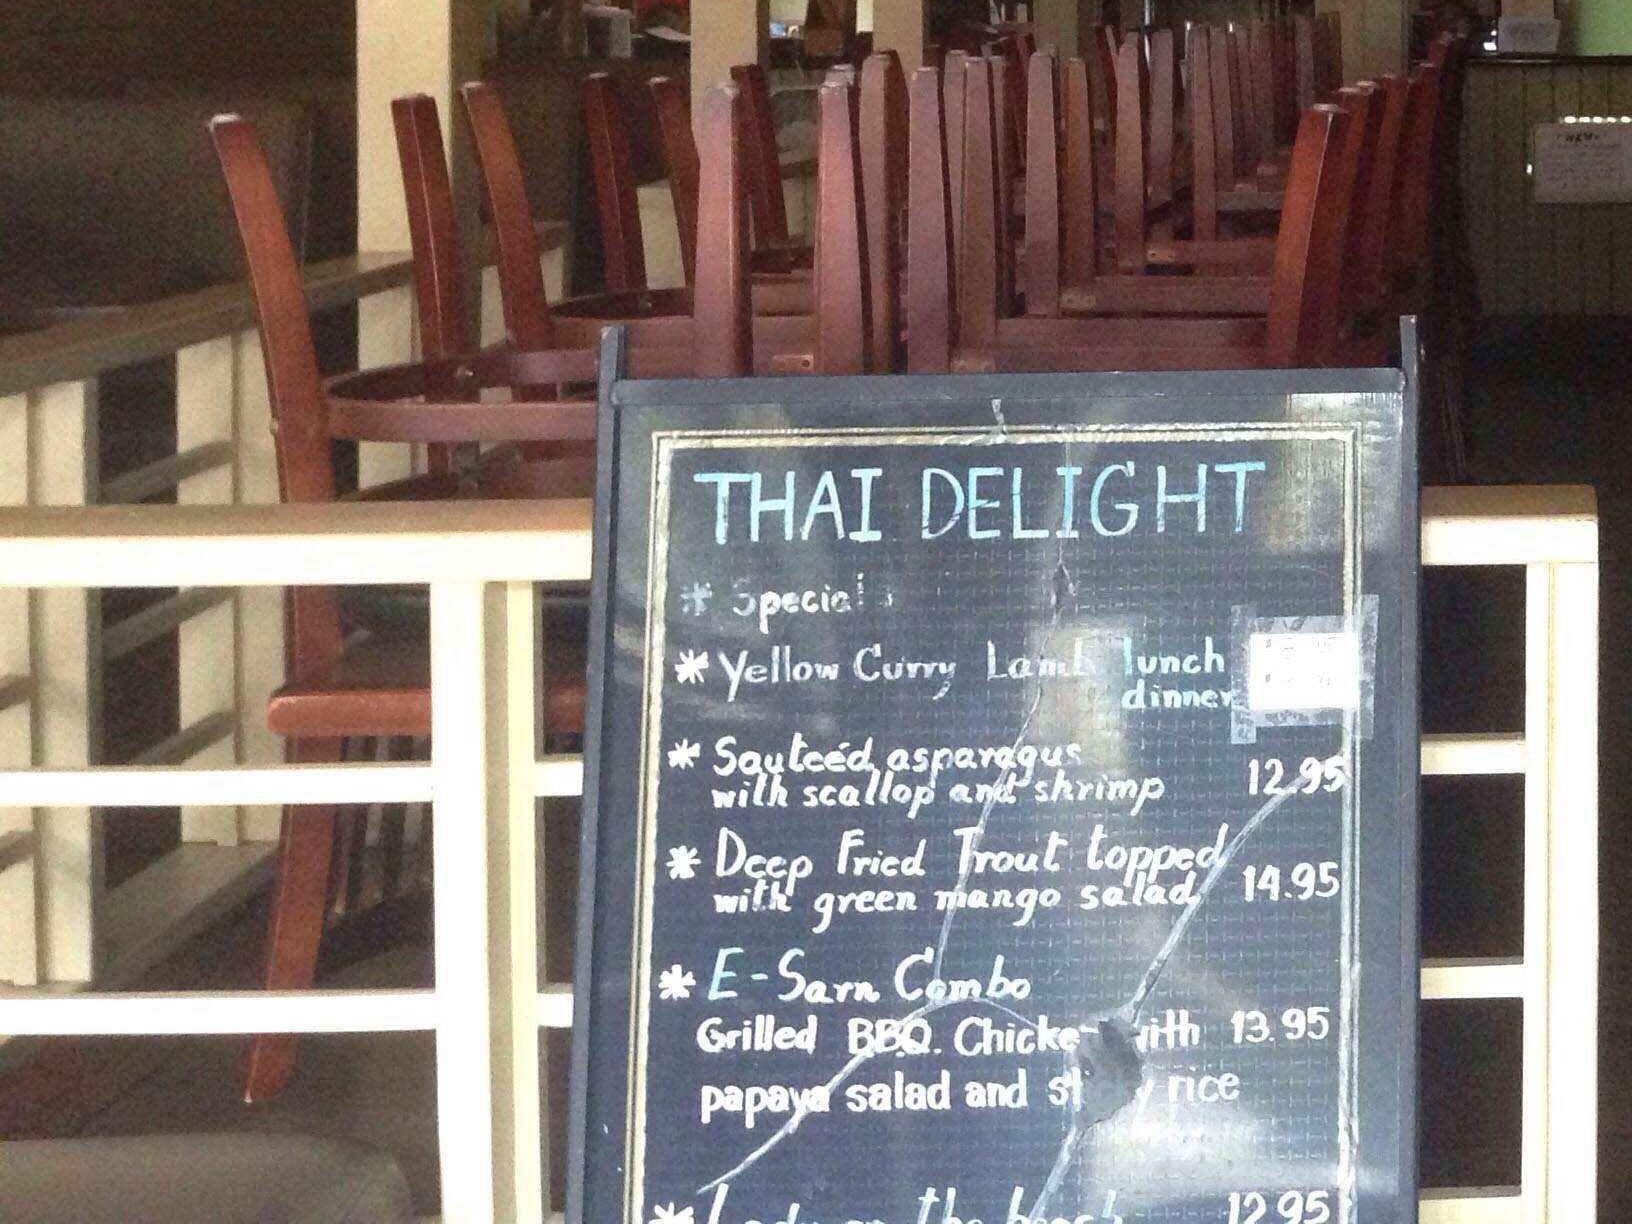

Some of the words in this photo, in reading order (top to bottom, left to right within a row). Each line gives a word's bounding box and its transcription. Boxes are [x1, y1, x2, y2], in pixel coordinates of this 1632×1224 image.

[694, 468, 882, 544] THAI
[921, 461, 1266, 539] DELIGHT
[717, 645, 840, 702] Yellow
[853, 643, 956, 700] Curry
[1124, 636, 1225, 677] lunch
[1121, 679, 1231, 709] dinner
[887, 742, 1082, 788] asparagus
[1248, 758, 1345, 795] 12.95
[711, 773, 788, 808] with
[803, 769, 935, 819] scallop
[950, 772, 1016, 804] and
[1034, 769, 1165, 816] shrimp
[715, 827, 814, 896] Deep
[837, 829, 926, 876] Fried
[953, 827, 1068, 874] Trout
[1087, 823, 1228, 887] topped
[1243, 862, 1340, 902] 14.95
[713, 879, 792, 913] with
[812, 888, 918, 933] green
[933, 886, 1061, 927] mango
[1079, 871, 1201, 909] salad
[894, 947, 1031, 1000] Combo
[697, 1015, 818, 1054] Grilled
[954, 1015, 1100, 1057] Chicke
[1231, 1007, 1330, 1043] 13.95
[701, 1085, 830, 1134] papaya
[846, 1070, 951, 1113] salad
[964, 1068, 1027, 1109] and
[1167, 1073, 1240, 1102] rice
[1228, 1190, 1330, 1224] 1295
